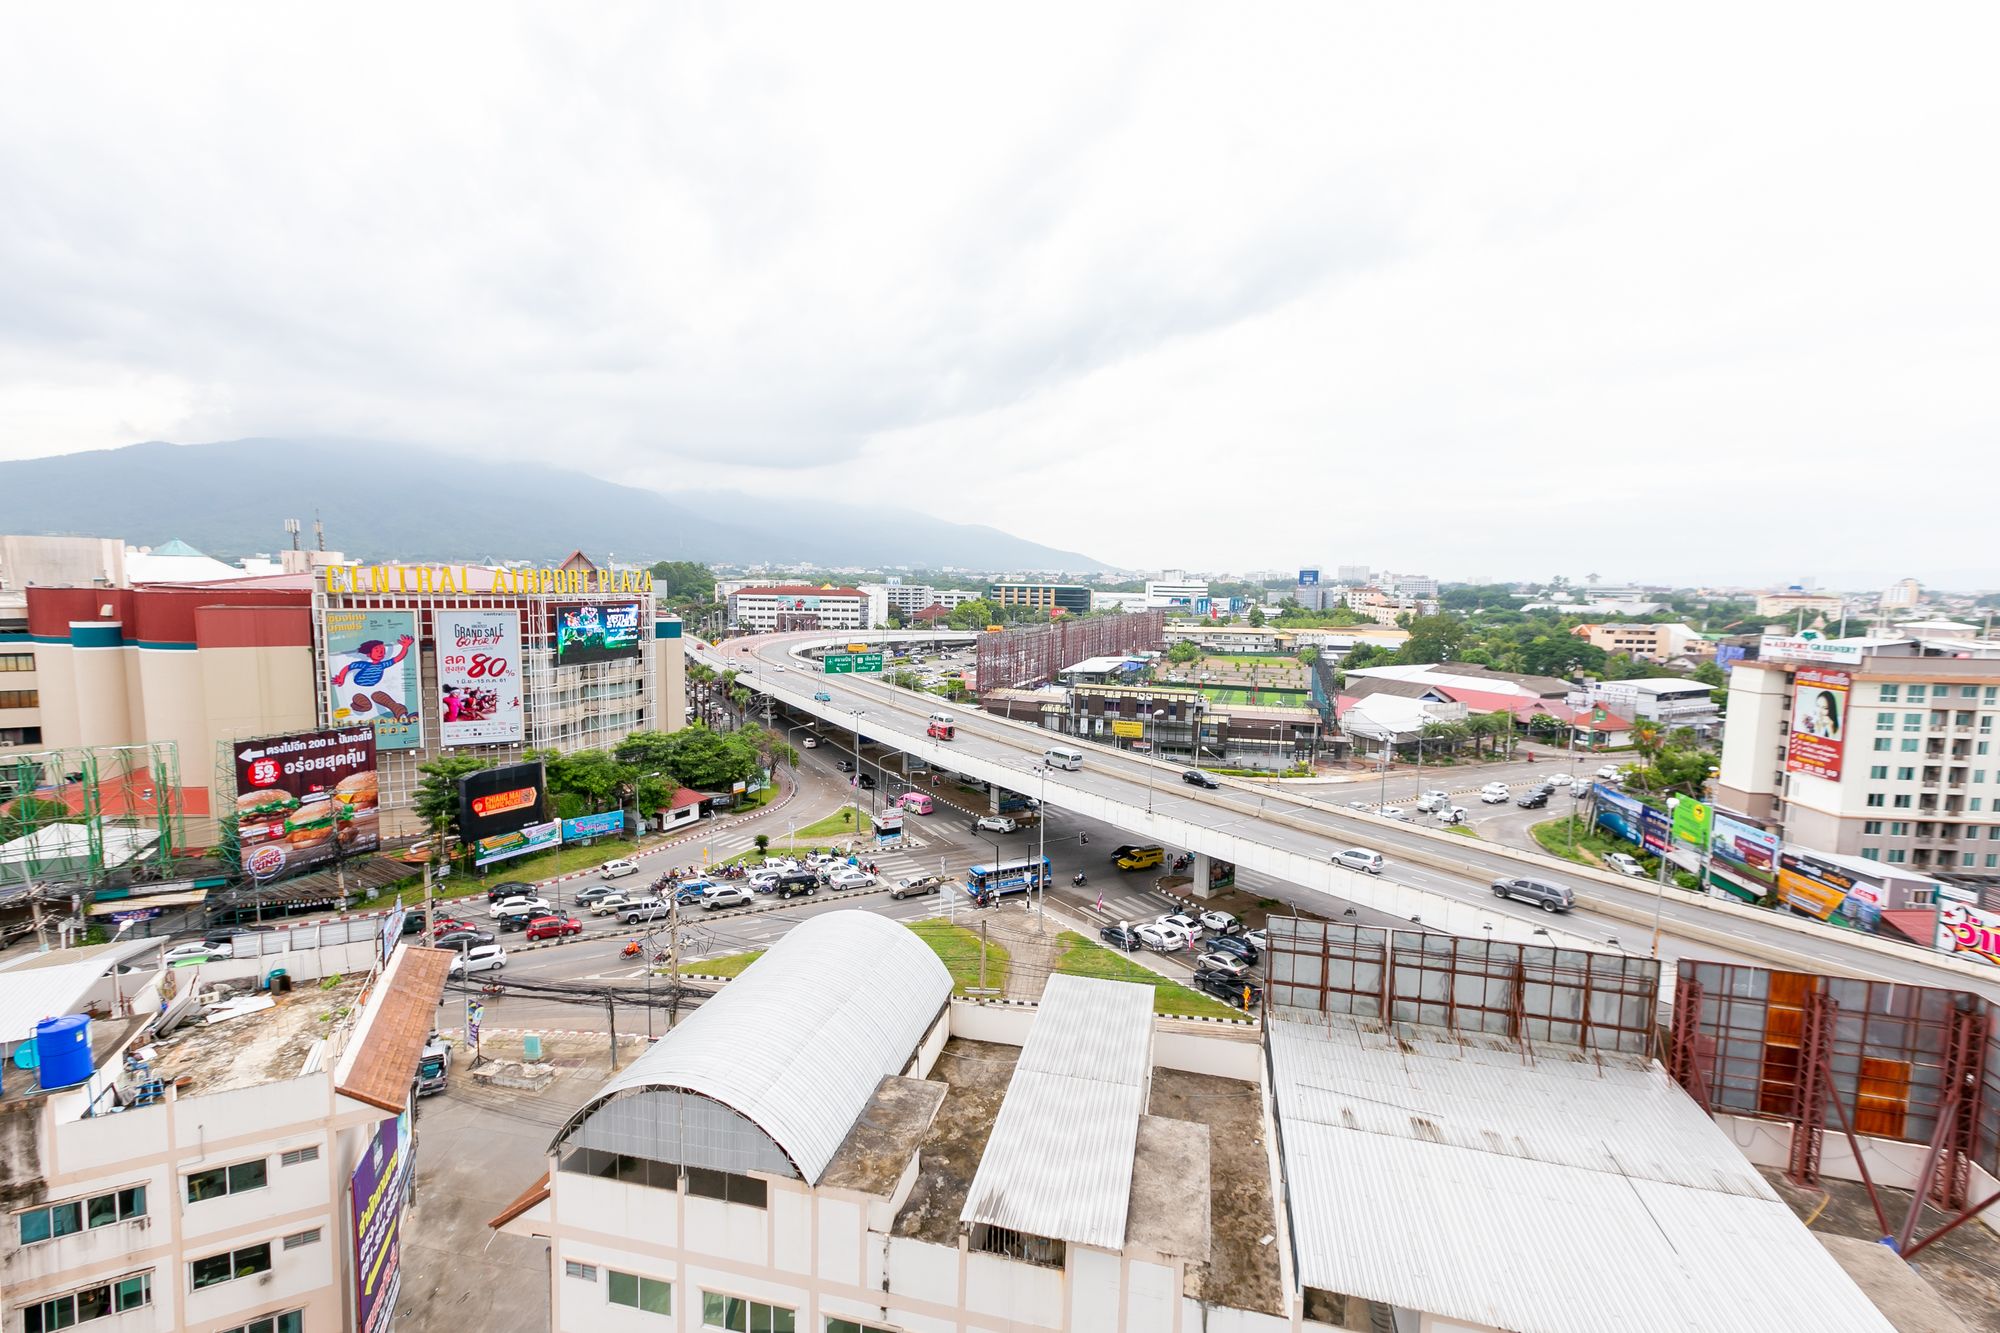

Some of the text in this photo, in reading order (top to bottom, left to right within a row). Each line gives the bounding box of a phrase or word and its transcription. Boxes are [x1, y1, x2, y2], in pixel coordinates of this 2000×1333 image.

[326, 564, 654, 595] CENTRAL AIRPORT PLAZA
[454, 623, 504, 639] GRAND SALE
[456, 637, 471, 648] GO
[444, 655, 466, 665] ลด
[308, 739, 326, 749] 200
[327, 738, 338, 747] ม.
[284, 748, 367, 775] อร่อยสุดคุ้ม
[484, 790, 521, 804] CHIANG MAI
[485, 798, 521, 810] TRAFFIC POLICE
[252, 849, 281, 867] BURGER
[255, 855, 281, 871] KING
